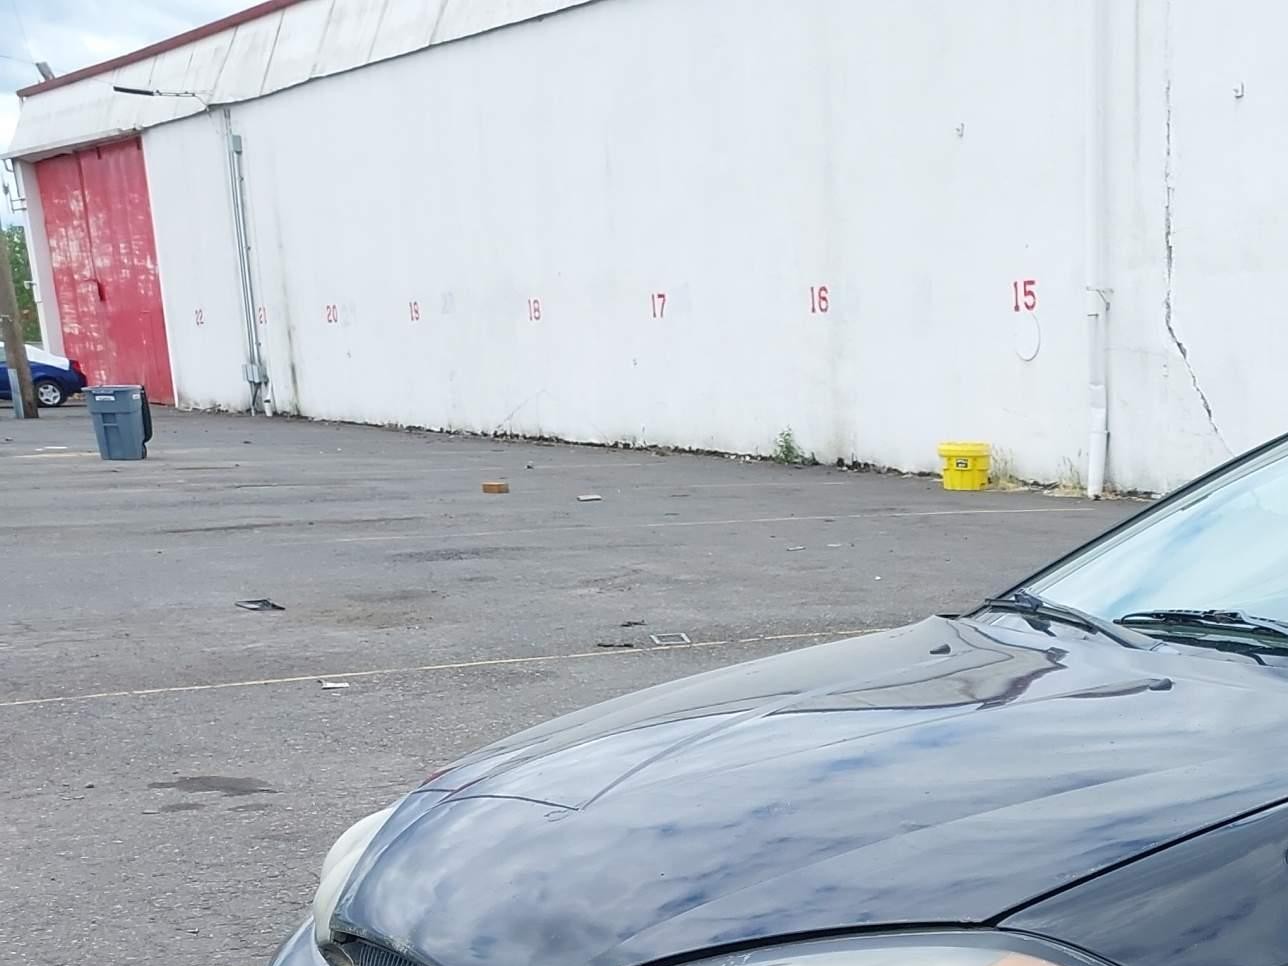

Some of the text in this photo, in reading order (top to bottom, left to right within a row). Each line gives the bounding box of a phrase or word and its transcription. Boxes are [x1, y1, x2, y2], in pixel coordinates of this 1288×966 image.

[650, 293, 667, 319] 17
[810, 286, 830, 314] 16
[1013, 280, 1037, 313] 15
[194, 308, 205, 327] 22
[326, 304, 339, 324] 20
[527, 298, 542, 321] 18
